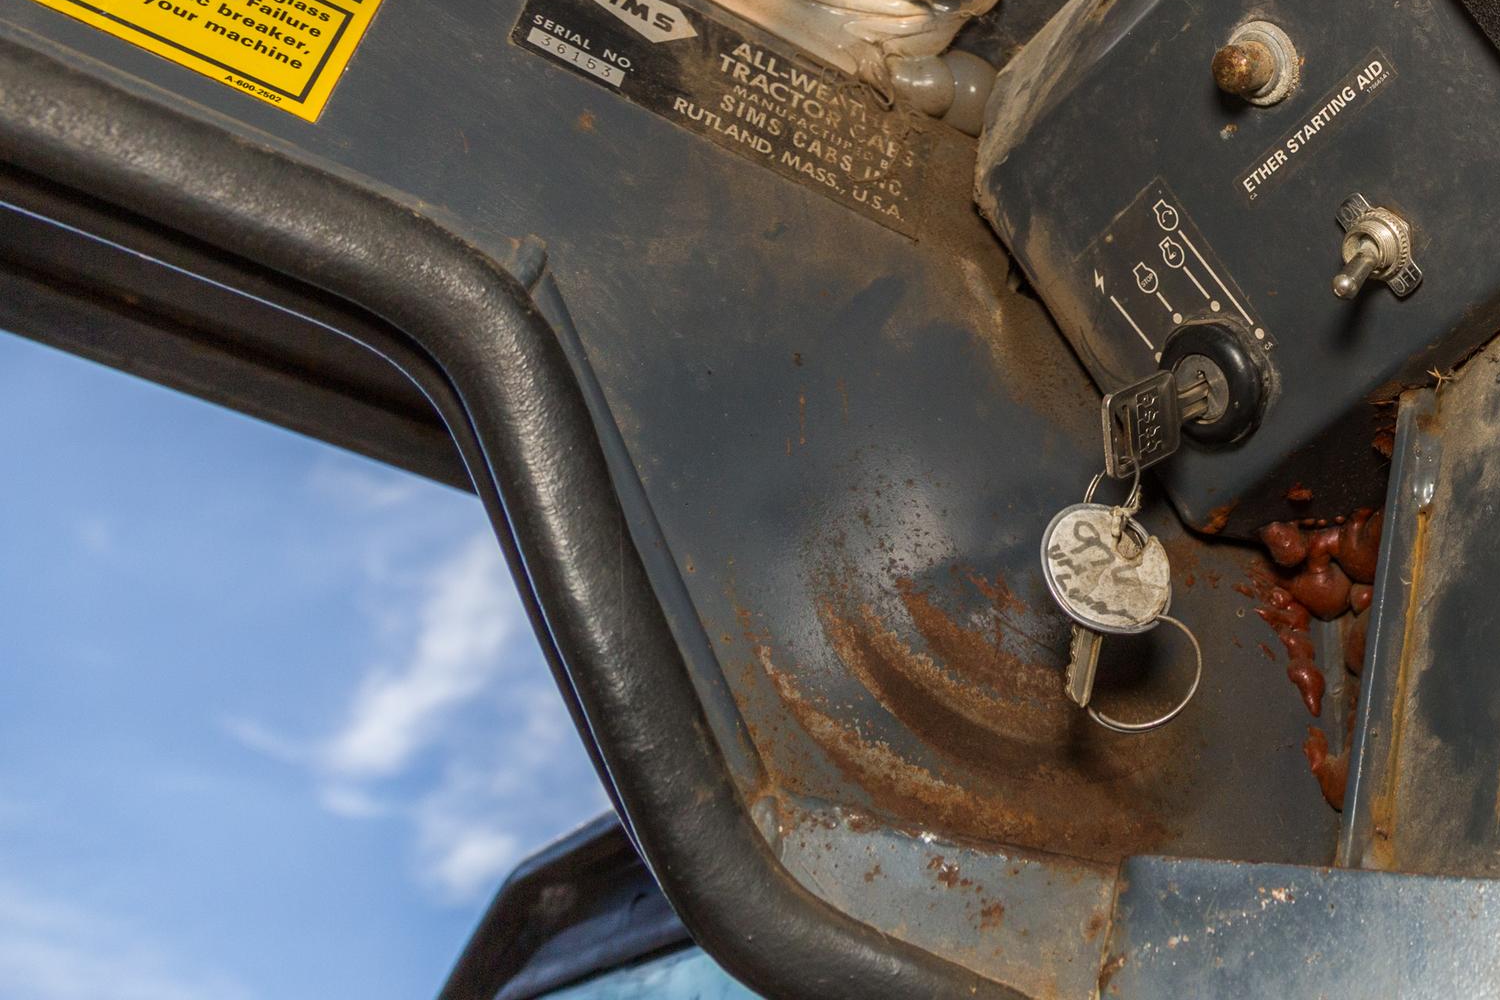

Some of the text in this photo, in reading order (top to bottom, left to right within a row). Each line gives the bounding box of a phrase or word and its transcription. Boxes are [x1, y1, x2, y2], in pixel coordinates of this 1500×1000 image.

[204, 20, 303, 70] machine
[217, 3, 311, 55] breaker,
[532, 14, 635, 72] SERIAL NO.
[224, 75, 283, 103] A-600-2502
[719, 53, 843, 129] TRACTOR
[720, 95, 781, 136] SIMS
[793, 131, 853, 172] CABS
[1242, 60, 1383, 193] ETHER STARTING AID
[673, 97, 776, 159] RUTLAND,
[852, 185, 905, 222] U.S.A.
[1341, 198, 1363, 222] ON
[1141, 273, 1155, 288] STOP
[1392, 266, 1417, 292] OFF
